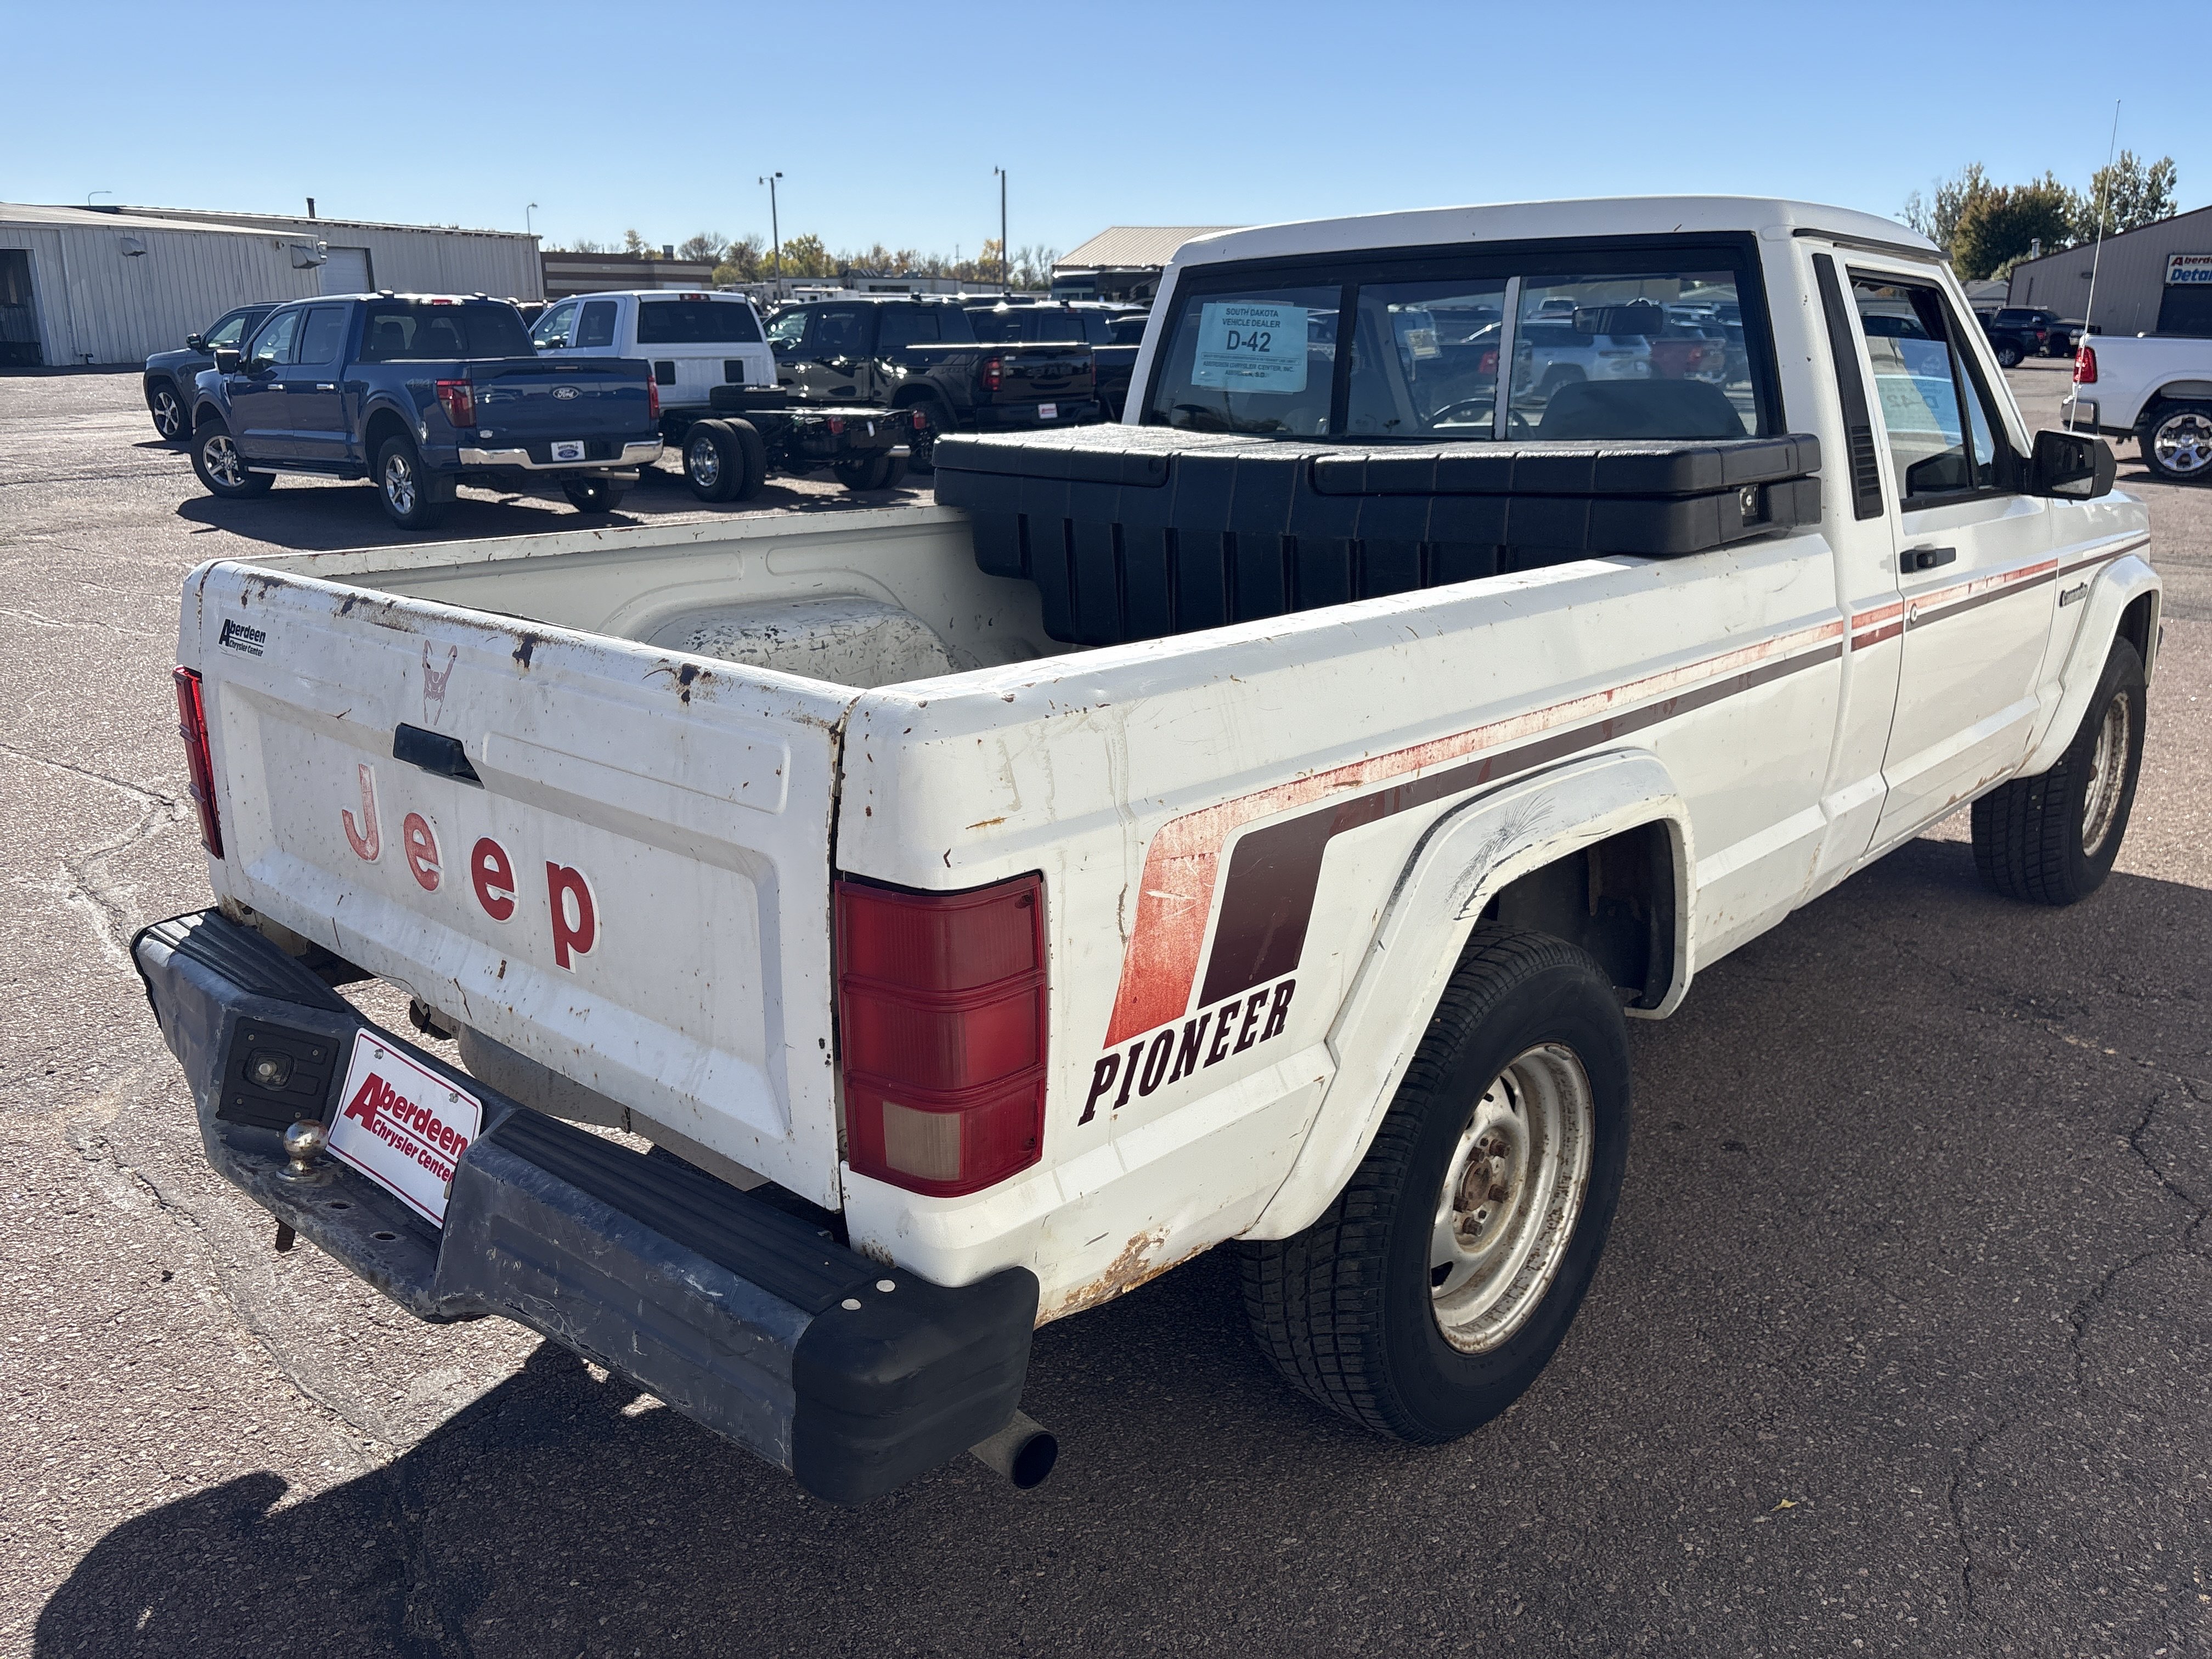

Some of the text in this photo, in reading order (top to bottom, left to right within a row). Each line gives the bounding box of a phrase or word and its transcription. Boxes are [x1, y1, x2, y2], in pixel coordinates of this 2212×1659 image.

[1222, 318, 1281, 328] VEHICLE DEALER
[1226, 308, 1279, 318] SOUTH DAKOTA
[1227, 330, 1271, 352] D-42
[218, 618, 266, 647] Aberdeen
[228, 639, 264, 657] Chrysler Center
[341, 763, 599, 972] Jeep
[1077, 979, 1296, 1127] PIONEER
[343, 1072, 469, 1159] Aberdeen
[371, 1118, 420, 1159] Chrysler
